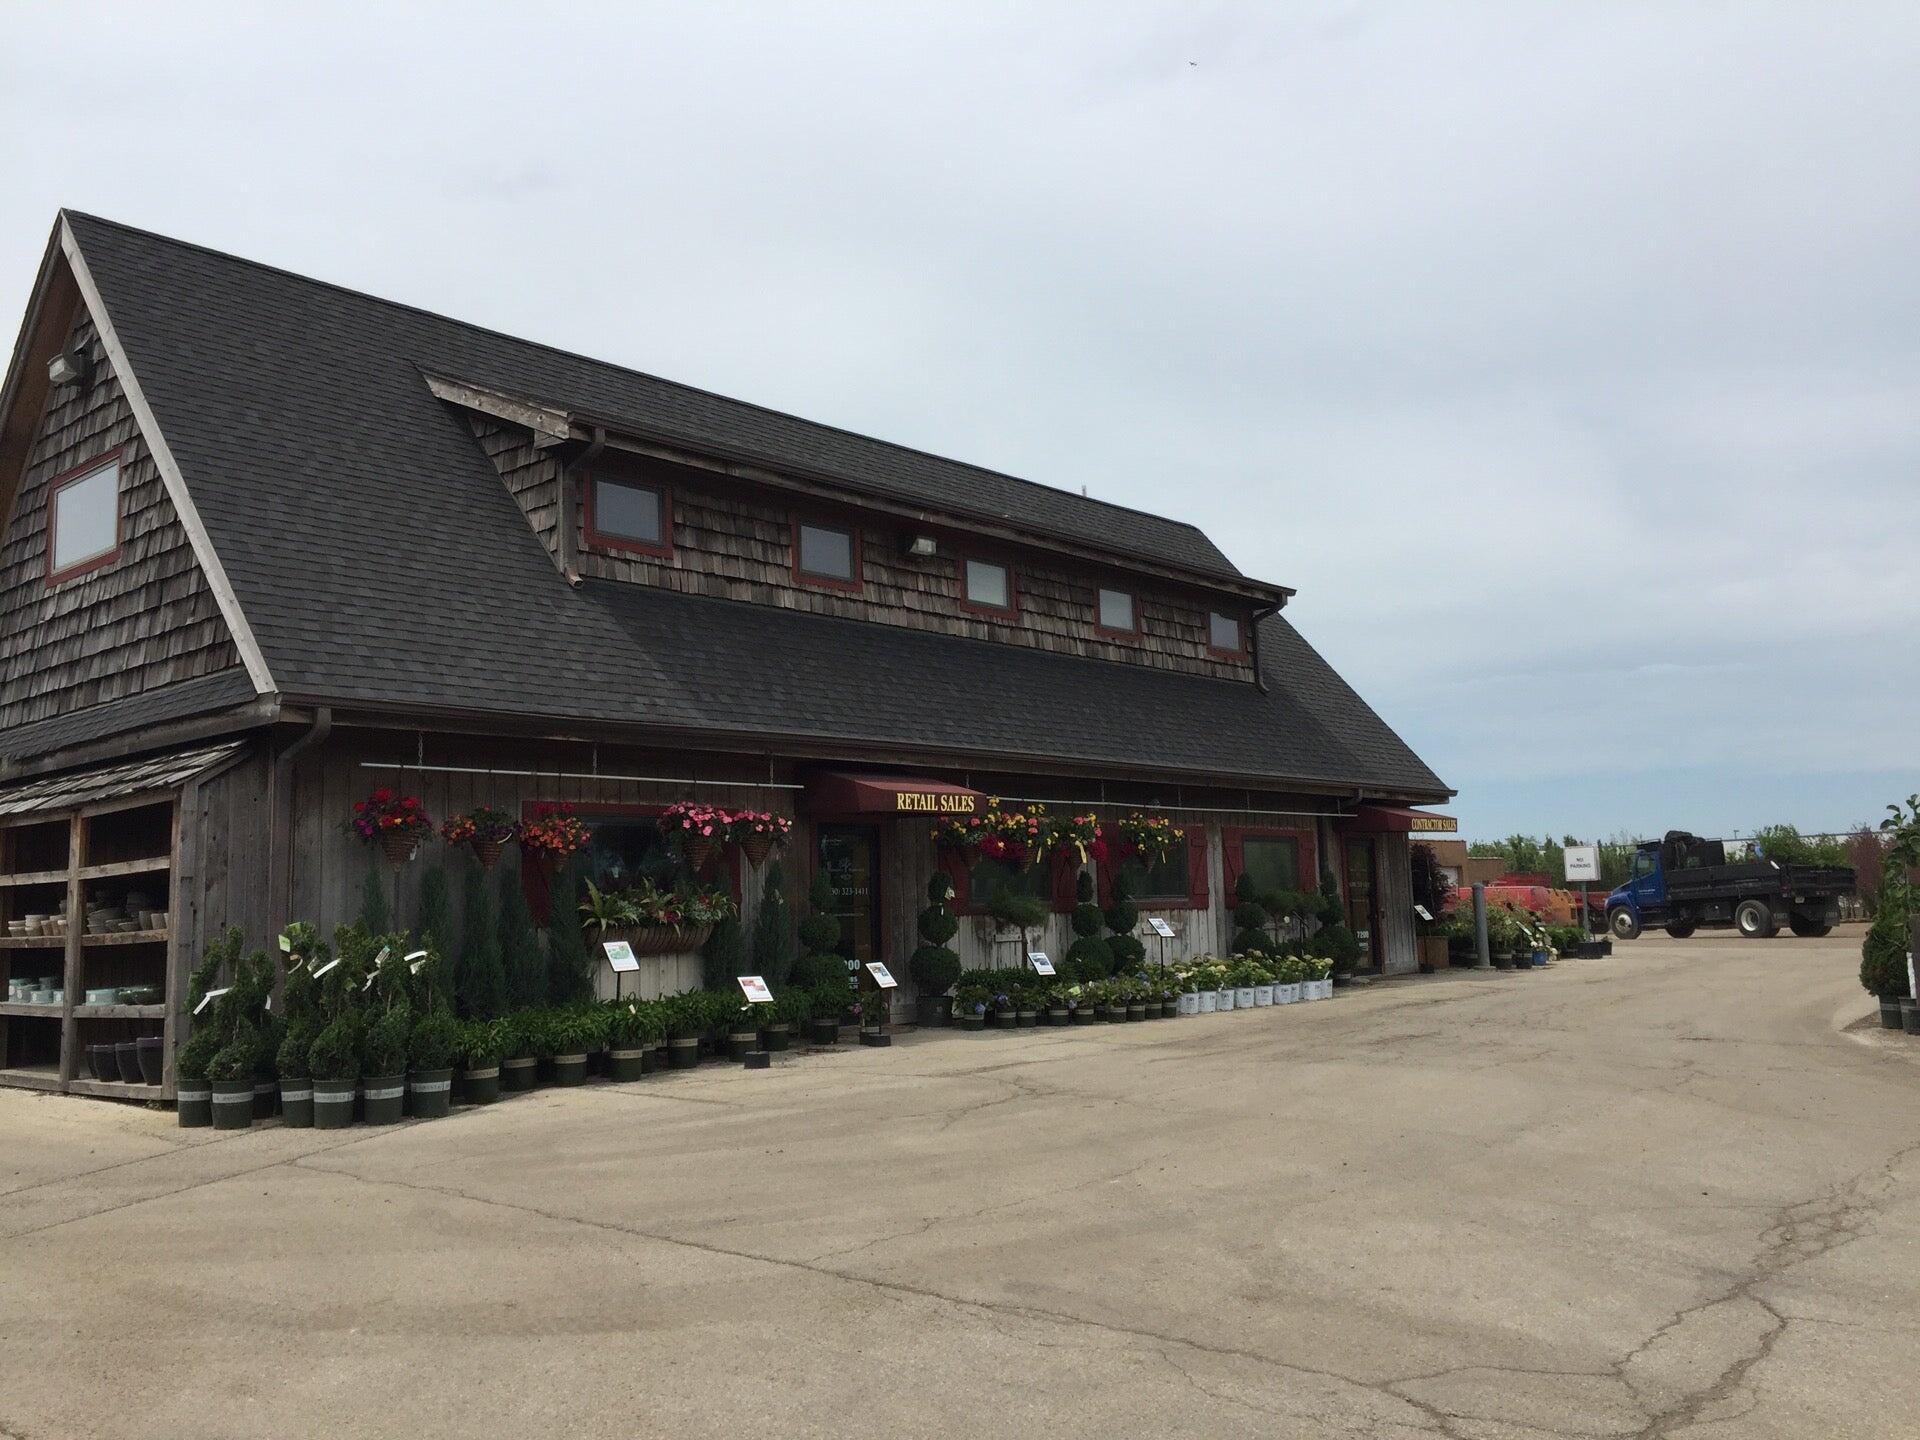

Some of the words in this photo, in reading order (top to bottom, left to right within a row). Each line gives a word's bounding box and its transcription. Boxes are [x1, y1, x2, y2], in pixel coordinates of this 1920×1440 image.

[897, 793, 938, 811] RETAIL
[940, 794, 975, 812] SALES
[1411, 817, 1442, 831] CONTRACTOR
[1443, 819, 1457, 831] SALES
